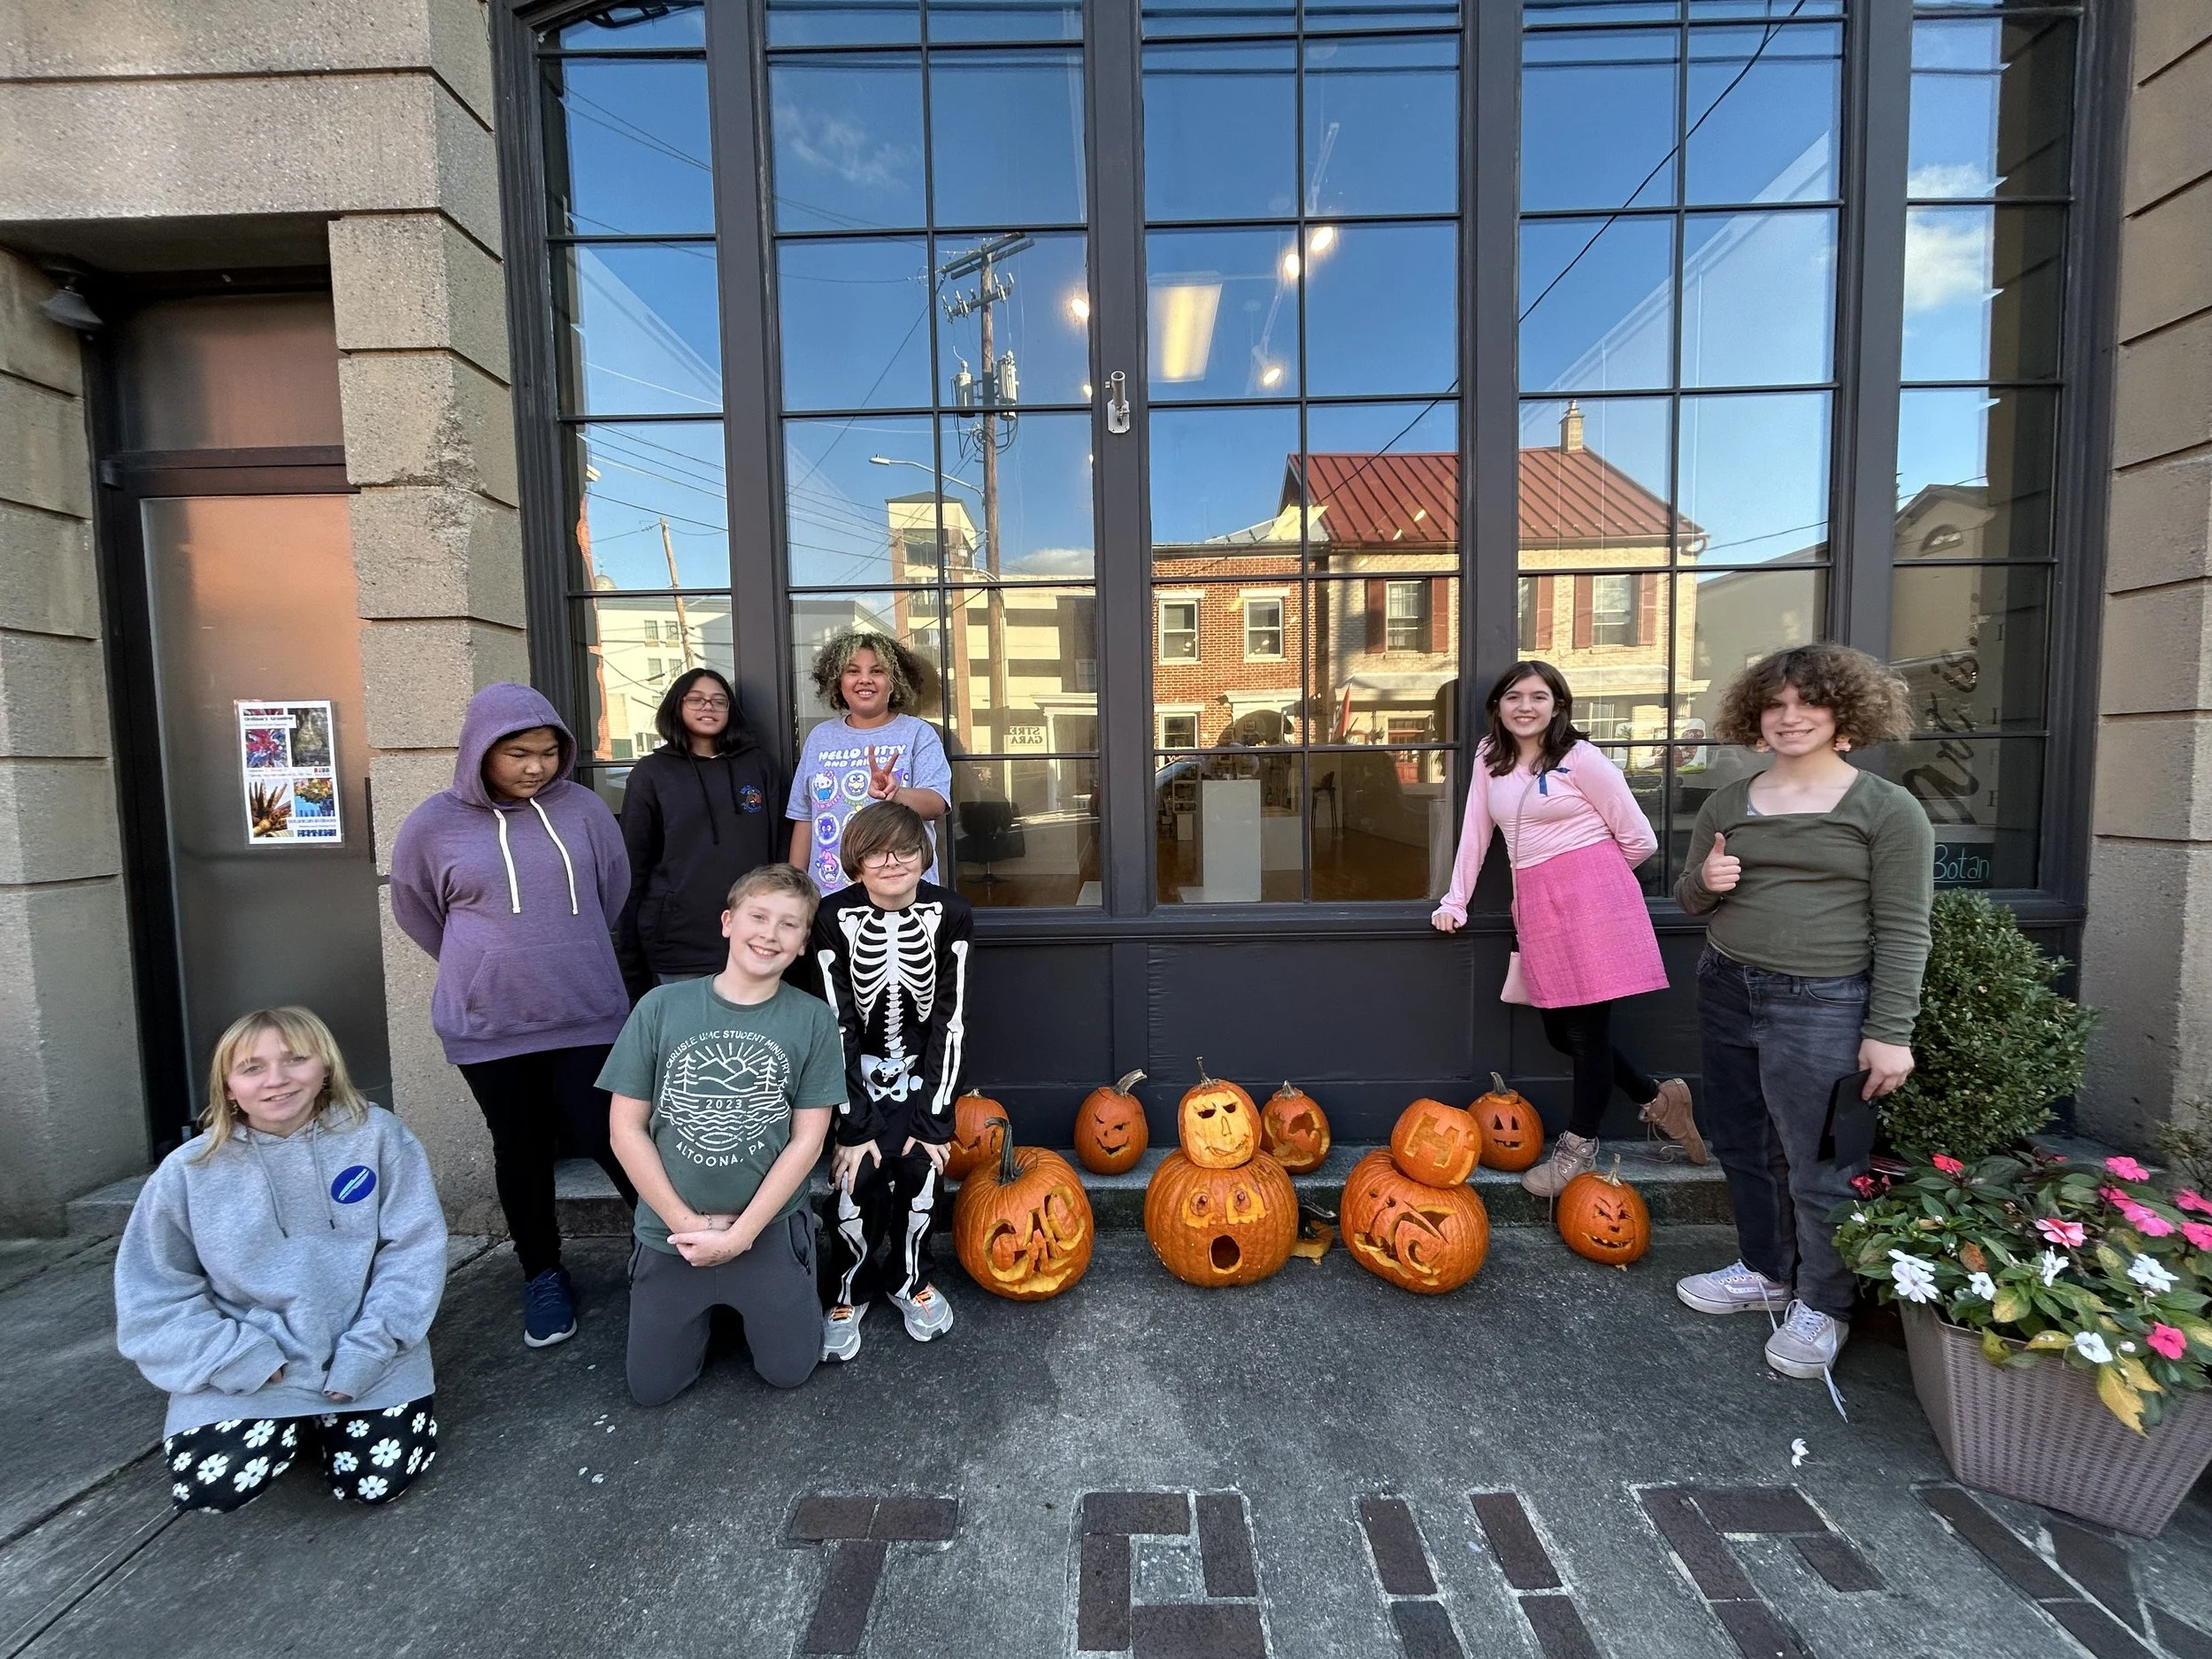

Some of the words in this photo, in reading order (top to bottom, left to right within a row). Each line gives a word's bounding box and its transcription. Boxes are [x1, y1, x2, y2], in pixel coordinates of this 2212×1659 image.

[818, 748, 862, 762] HELLO
[665, 1036, 698, 1069] CARLISLE
[699, 1030, 720, 1041] UMC
[723, 1030, 766, 1044] STUDENT
[764, 1039, 790, 1075] MINISTRY
[705, 1099, 742, 1110] 2023
[675, 1141, 744, 1167] ALTOONA,
[749, 1140, 765, 1156] PA
